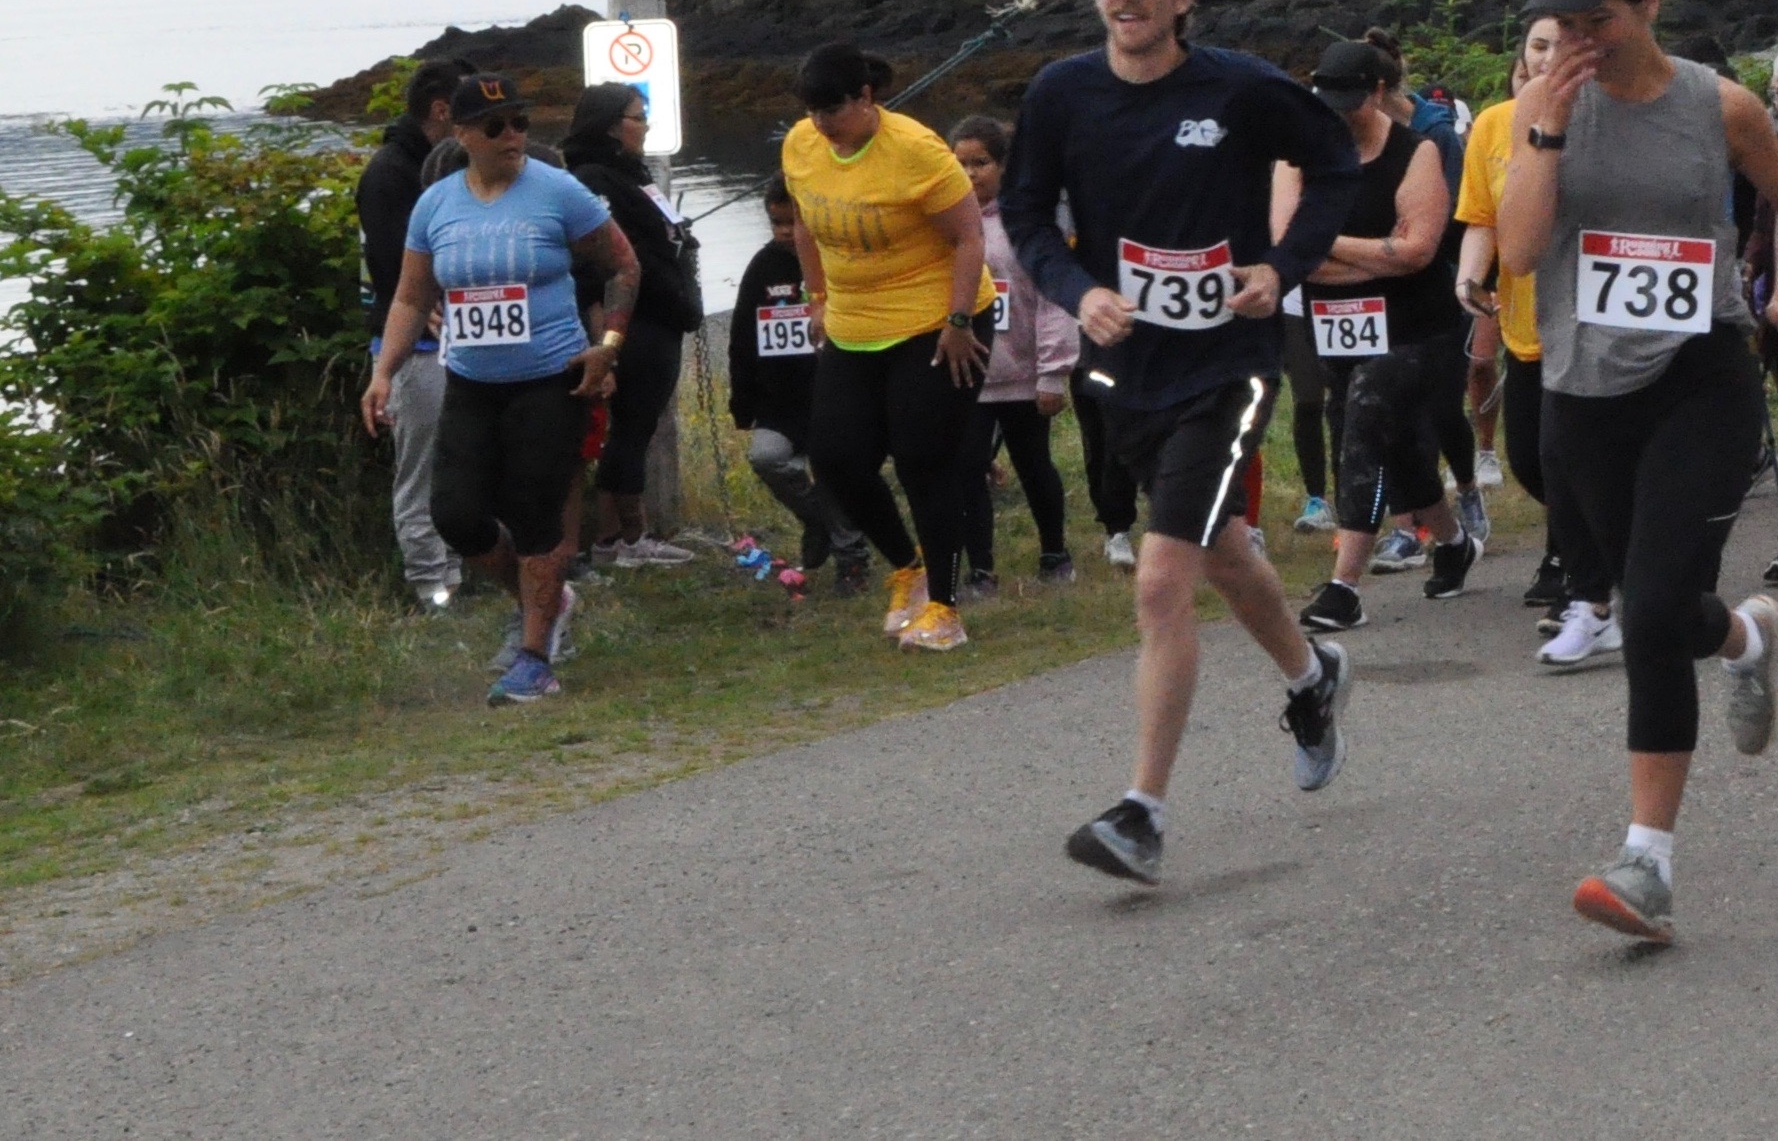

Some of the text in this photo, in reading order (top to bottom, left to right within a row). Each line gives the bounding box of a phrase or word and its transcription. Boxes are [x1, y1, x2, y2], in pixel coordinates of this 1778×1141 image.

[1131, 267, 1225, 320] 739
[1592, 261, 1698, 320] 738
[453, 303, 525, 339] 1948
[1320, 315, 1379, 350] 784
